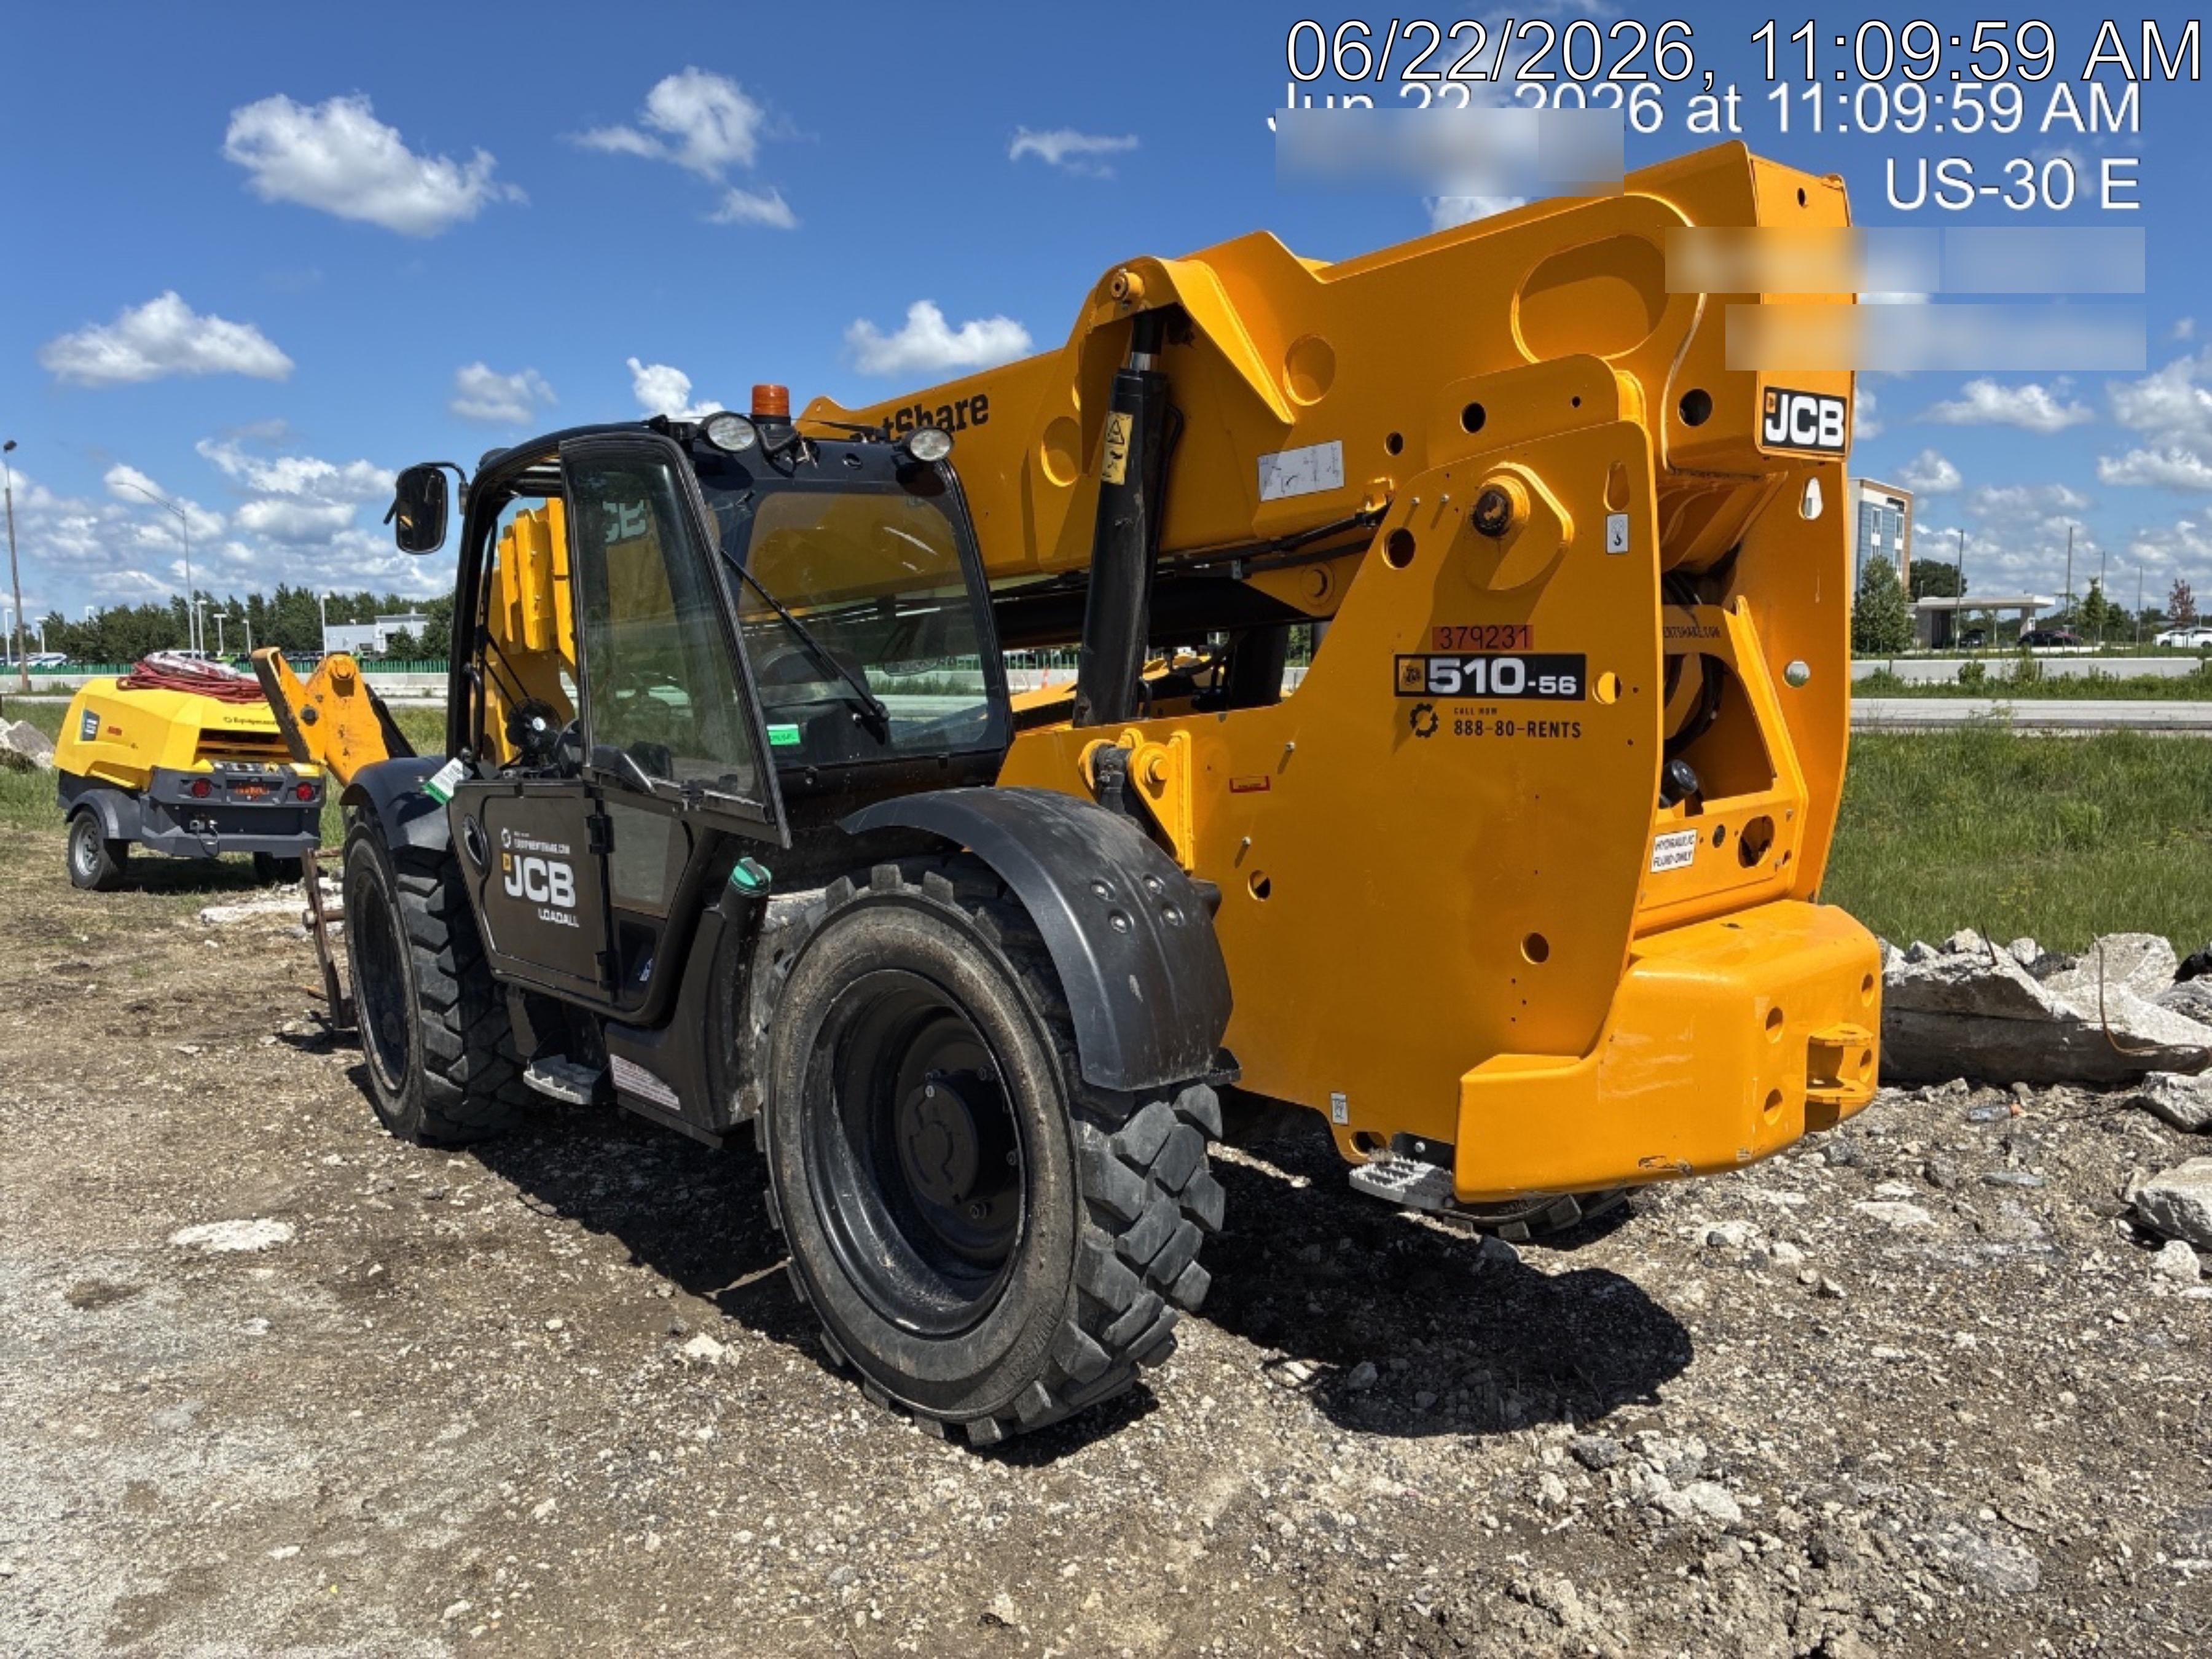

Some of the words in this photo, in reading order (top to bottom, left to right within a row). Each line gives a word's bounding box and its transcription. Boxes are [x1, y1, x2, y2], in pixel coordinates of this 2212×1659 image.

[881, 393, 990, 441] tShare
[1765, 393, 1845, 447] JCB
[1440, 625, 1530, 650] 379231
[1427, 657, 1578, 696] 510-56
[1454, 719, 1582, 738] 888-80-RENTS
[504, 855, 576, 908] JCB
[537, 908, 580, 928] LOADALL
